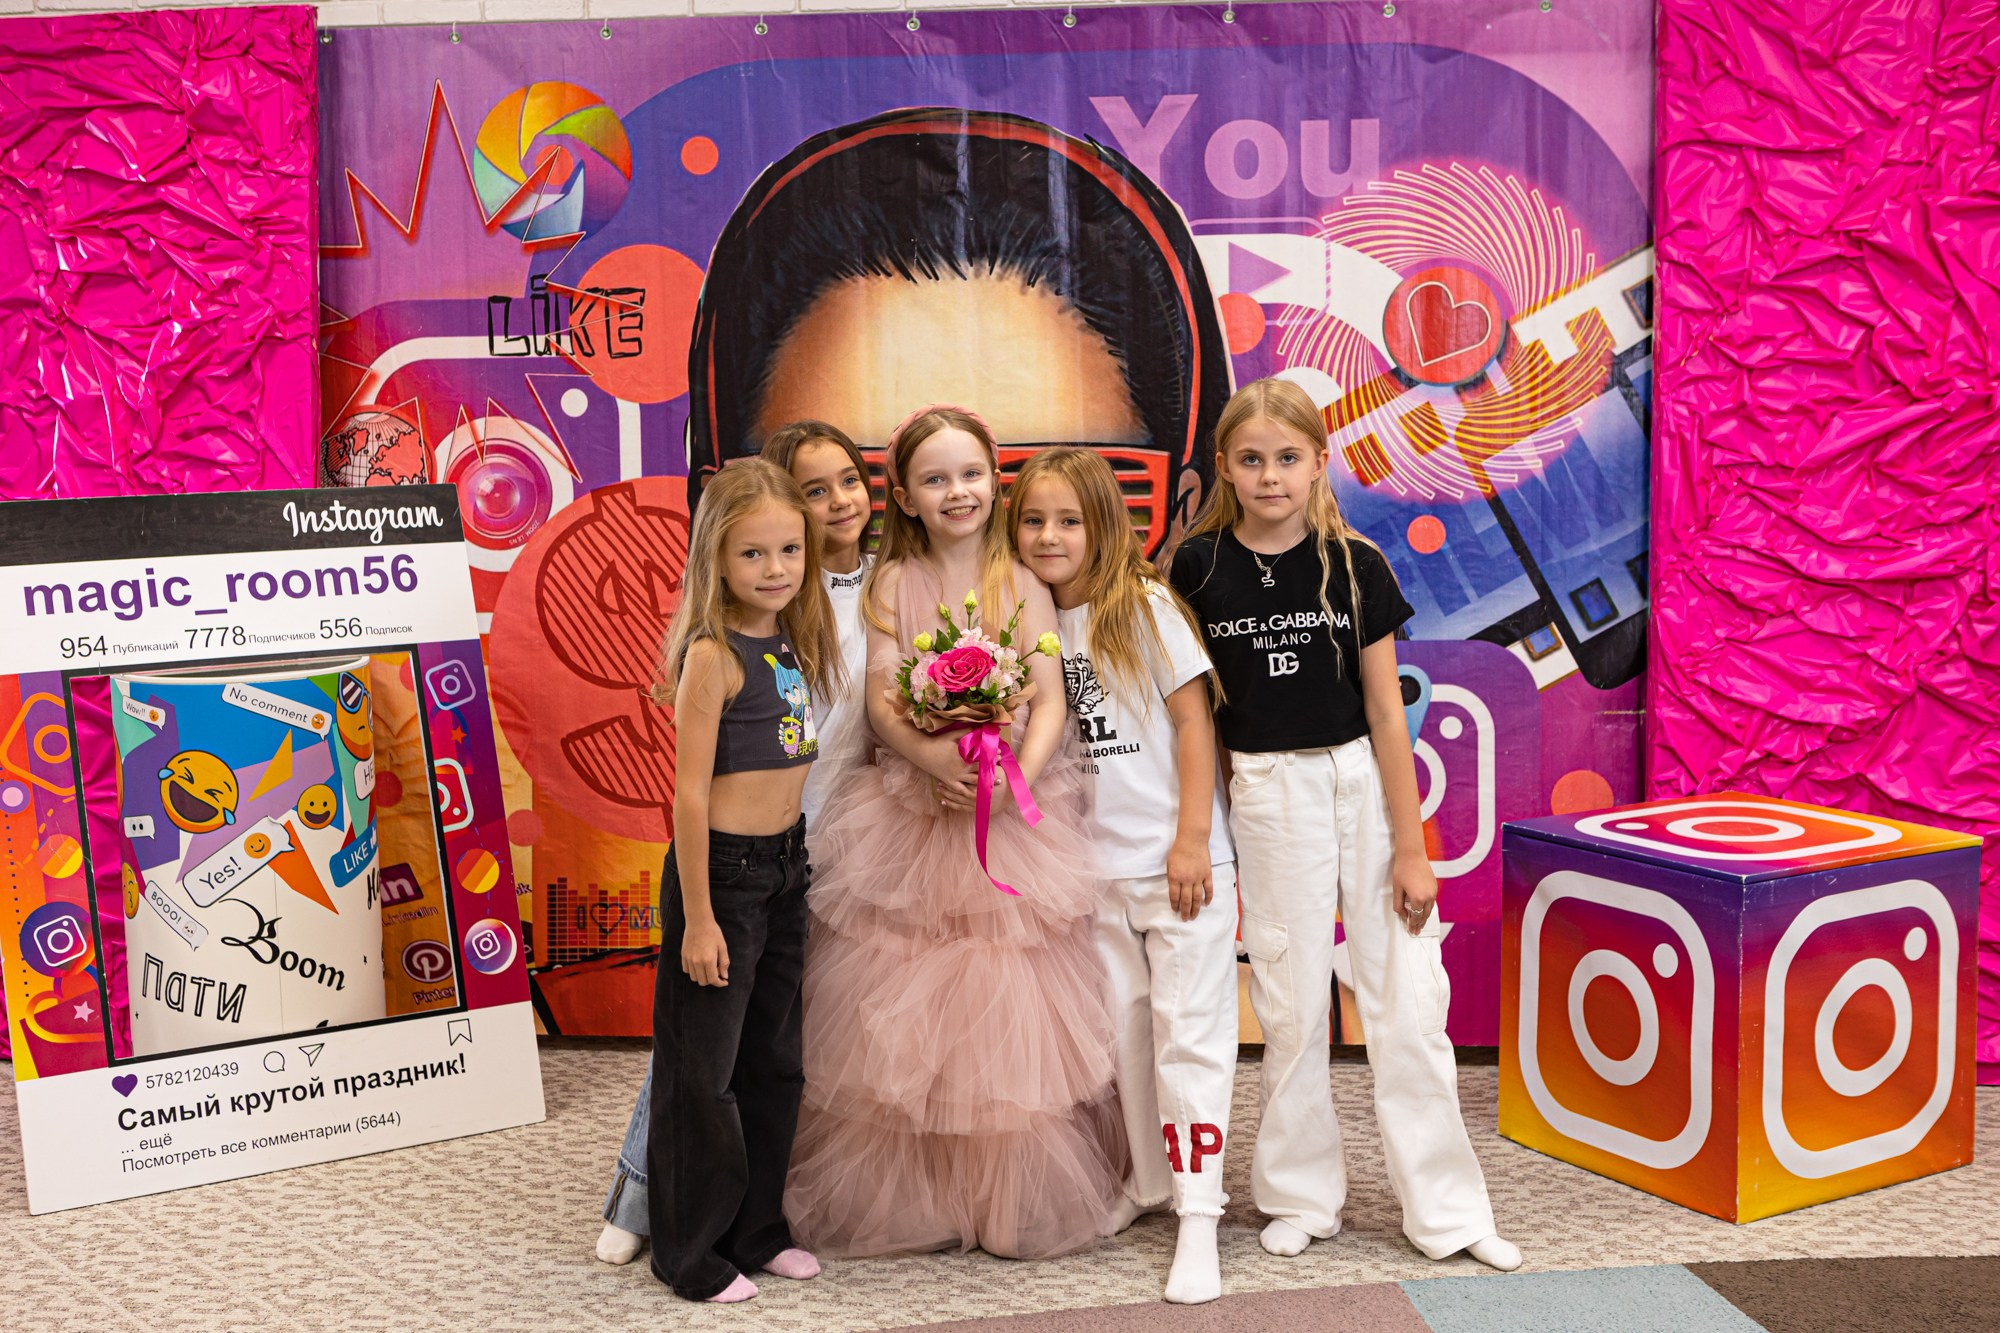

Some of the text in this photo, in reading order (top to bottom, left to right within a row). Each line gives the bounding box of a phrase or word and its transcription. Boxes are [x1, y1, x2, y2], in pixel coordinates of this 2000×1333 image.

[1089, 94, 1380, 200] You
[282, 500, 444, 544] Instagram
[23, 553, 418, 621] magic_room56
[60, 617, 413, 659] 954 Публикаций 7778 Подписчиков 556 Подписок
[1207, 611, 1351, 639] DOLCE & GABBANA
[1253, 632, 1312, 650] MILANO
[1267, 651, 1300, 677] DG
[229, 686, 308, 723] No comment
[1093, 743, 1140, 759] BORELLI
[199, 856, 242, 890] Yes!
[343, 841, 369, 874] LIKE
[150, 890, 182, 924] BOOO!
[218, 898, 346, 992] Boom
[117, 1053, 466, 1131] Самый крутой праздник!
[146, 1061, 239, 1089] 5782120439
[122, 1110, 402, 1173] Посмотреть все комментарии (5644)
[139, 1132, 173, 1151] ещё
